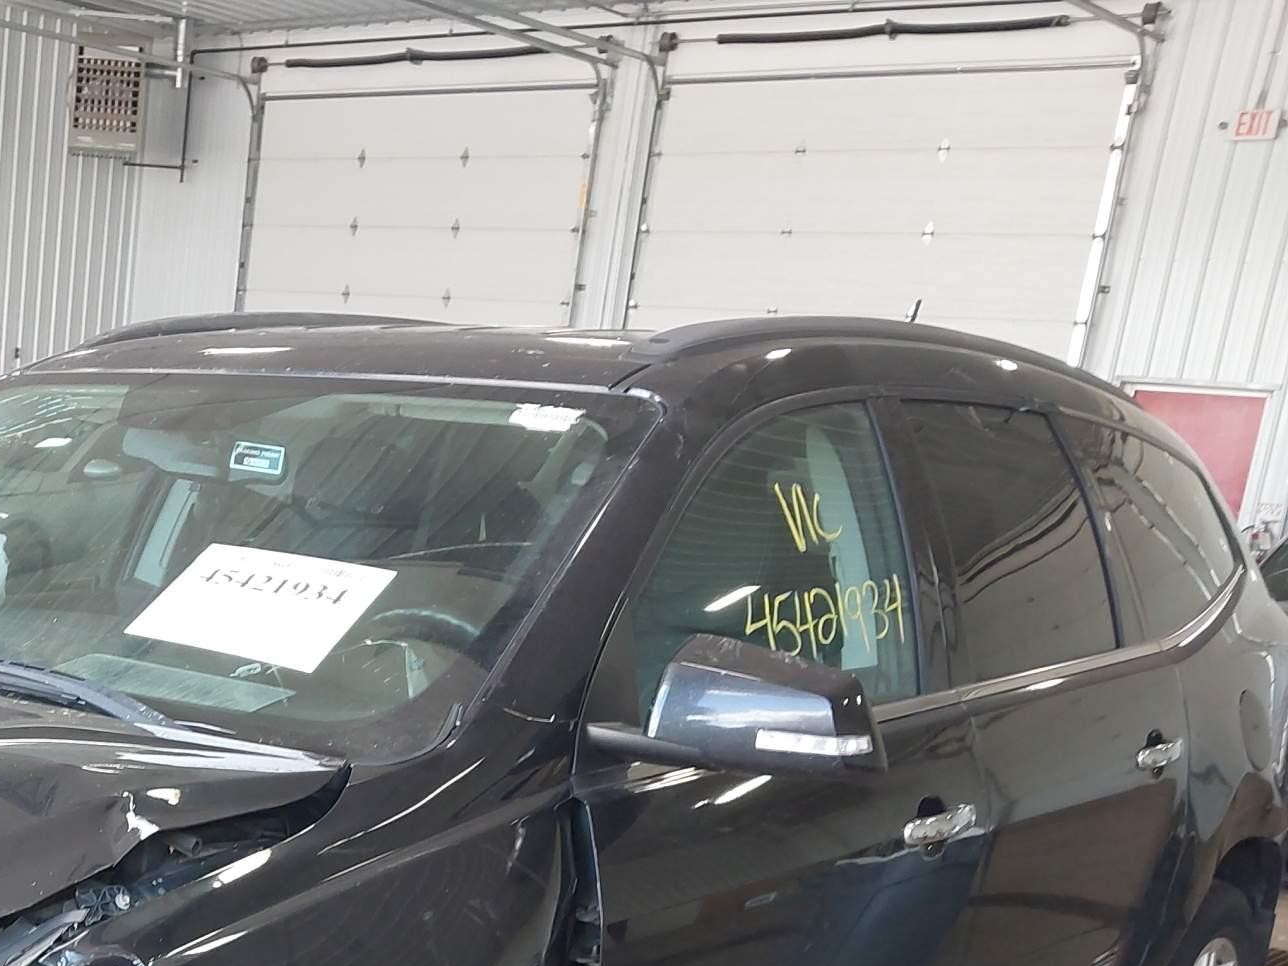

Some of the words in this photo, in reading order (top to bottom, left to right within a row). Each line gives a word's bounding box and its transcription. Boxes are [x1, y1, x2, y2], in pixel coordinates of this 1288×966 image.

[1235, 112, 1273, 137] EXIT
[199, 568, 349, 605] 45421934
[745, 573, 905, 660] 45421934
